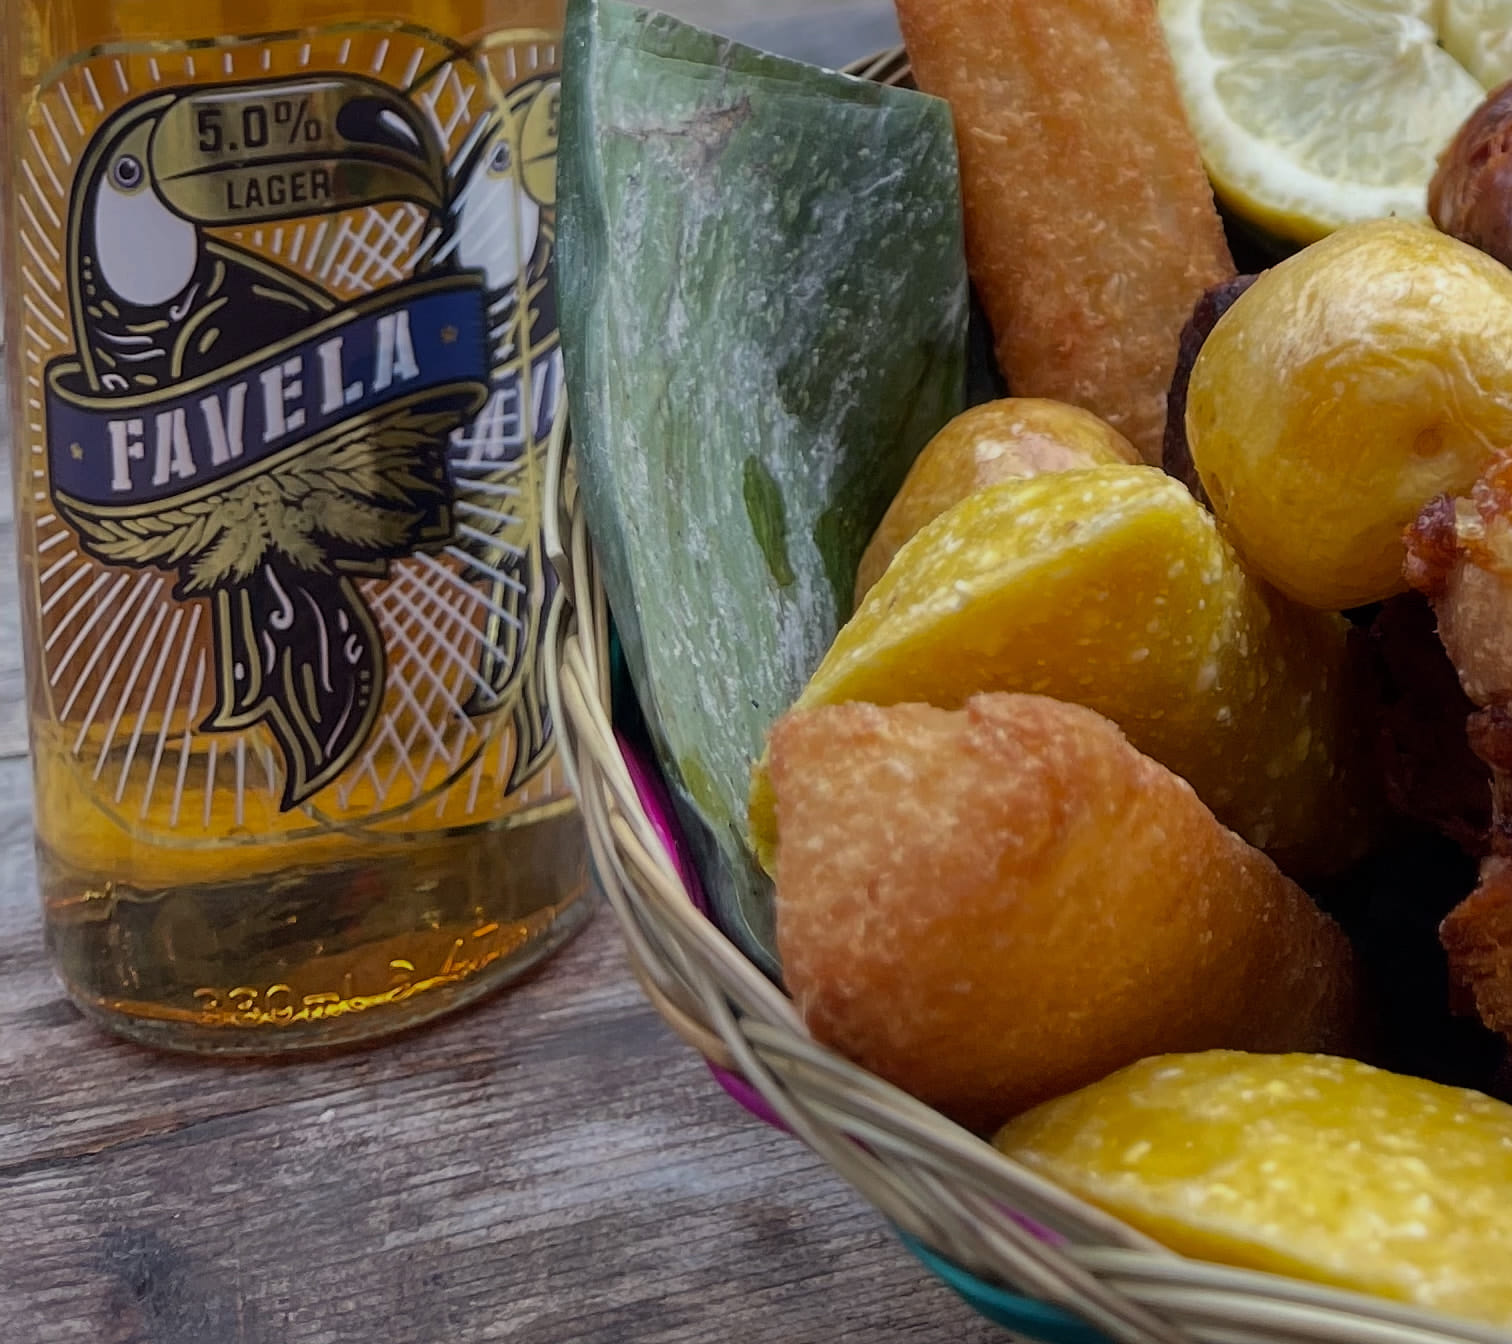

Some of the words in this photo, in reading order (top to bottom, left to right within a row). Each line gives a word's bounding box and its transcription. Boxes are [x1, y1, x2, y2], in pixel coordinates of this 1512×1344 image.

[198, 99, 321, 152] 5.0%
[227, 168, 330, 209] LAGER
[108, 310, 419, 490] FAVELA
